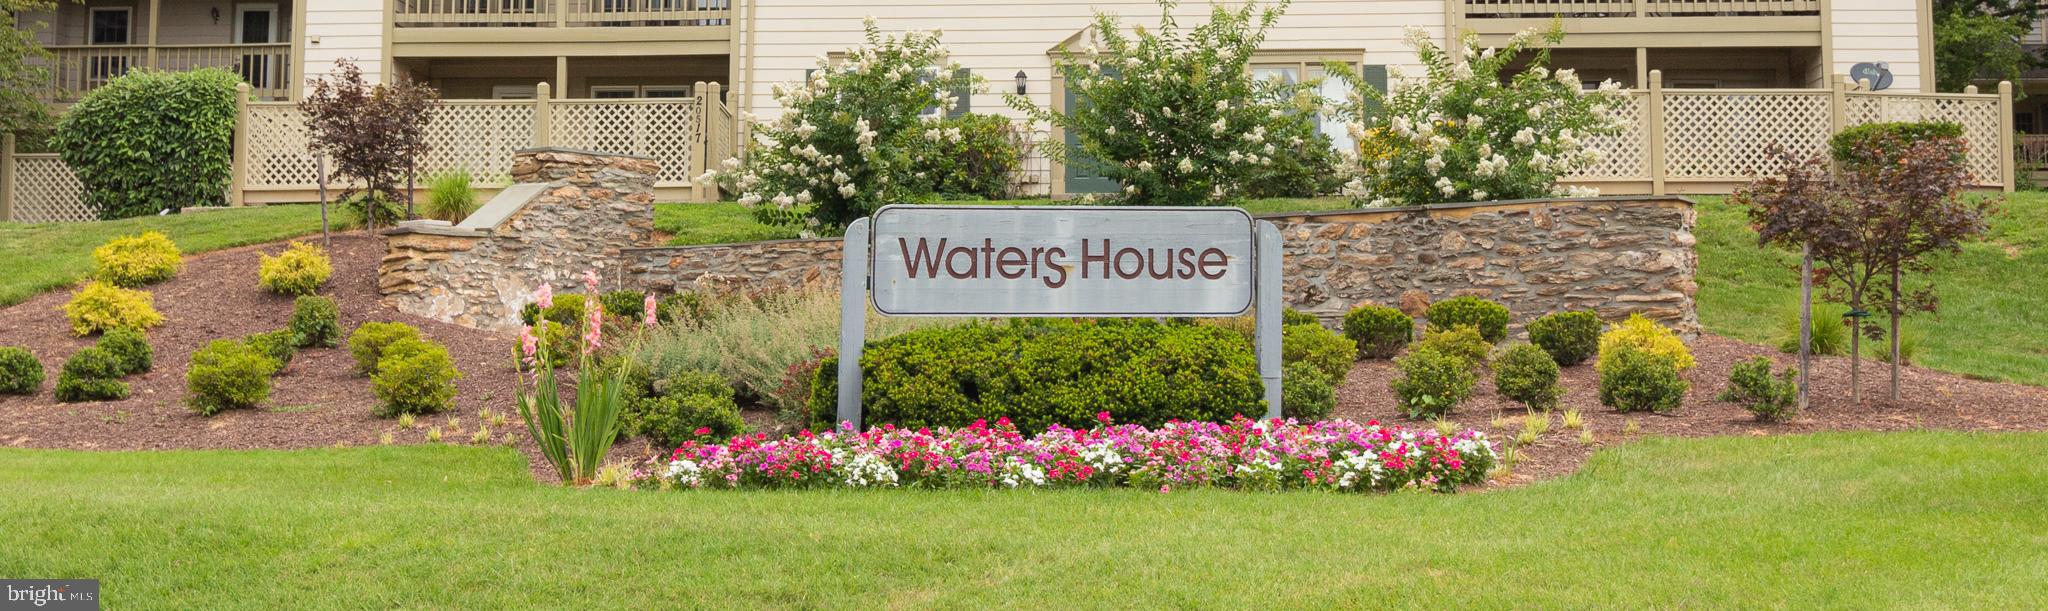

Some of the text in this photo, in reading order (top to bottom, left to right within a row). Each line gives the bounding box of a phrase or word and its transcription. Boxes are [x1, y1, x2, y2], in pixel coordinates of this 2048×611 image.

[695, 96, 703, 143] 20517
[898, 237, 1228, 289] Waters House
